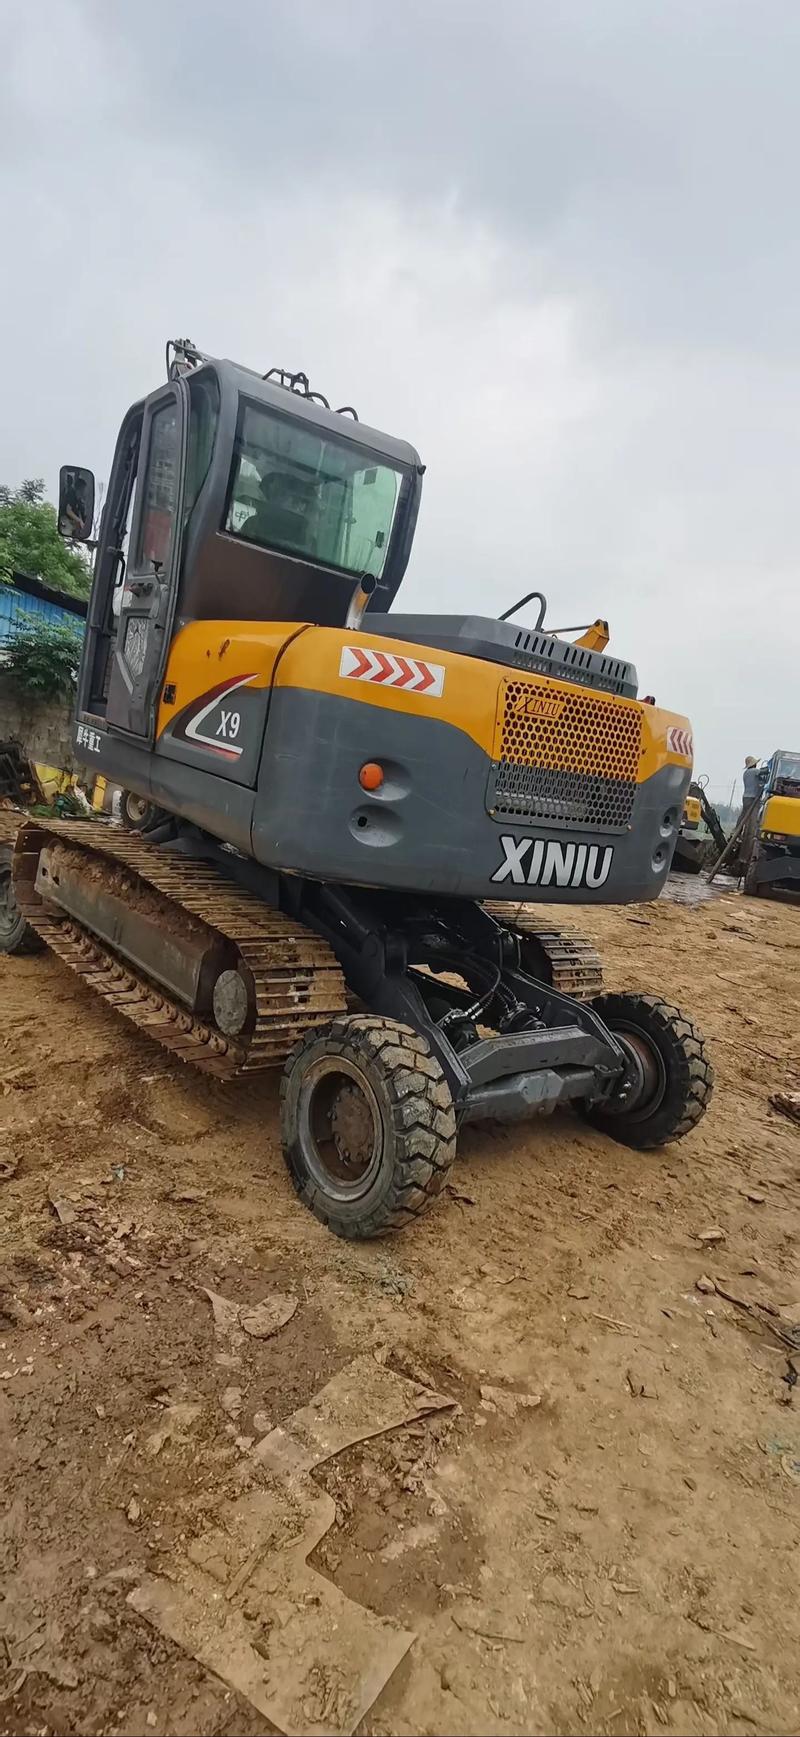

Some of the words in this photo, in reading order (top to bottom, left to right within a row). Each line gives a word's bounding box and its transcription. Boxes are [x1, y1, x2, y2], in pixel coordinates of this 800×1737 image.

[516, 697, 560, 716] XINIU
[215, 710, 240, 738] X9
[491, 836, 613, 888] XINIU
